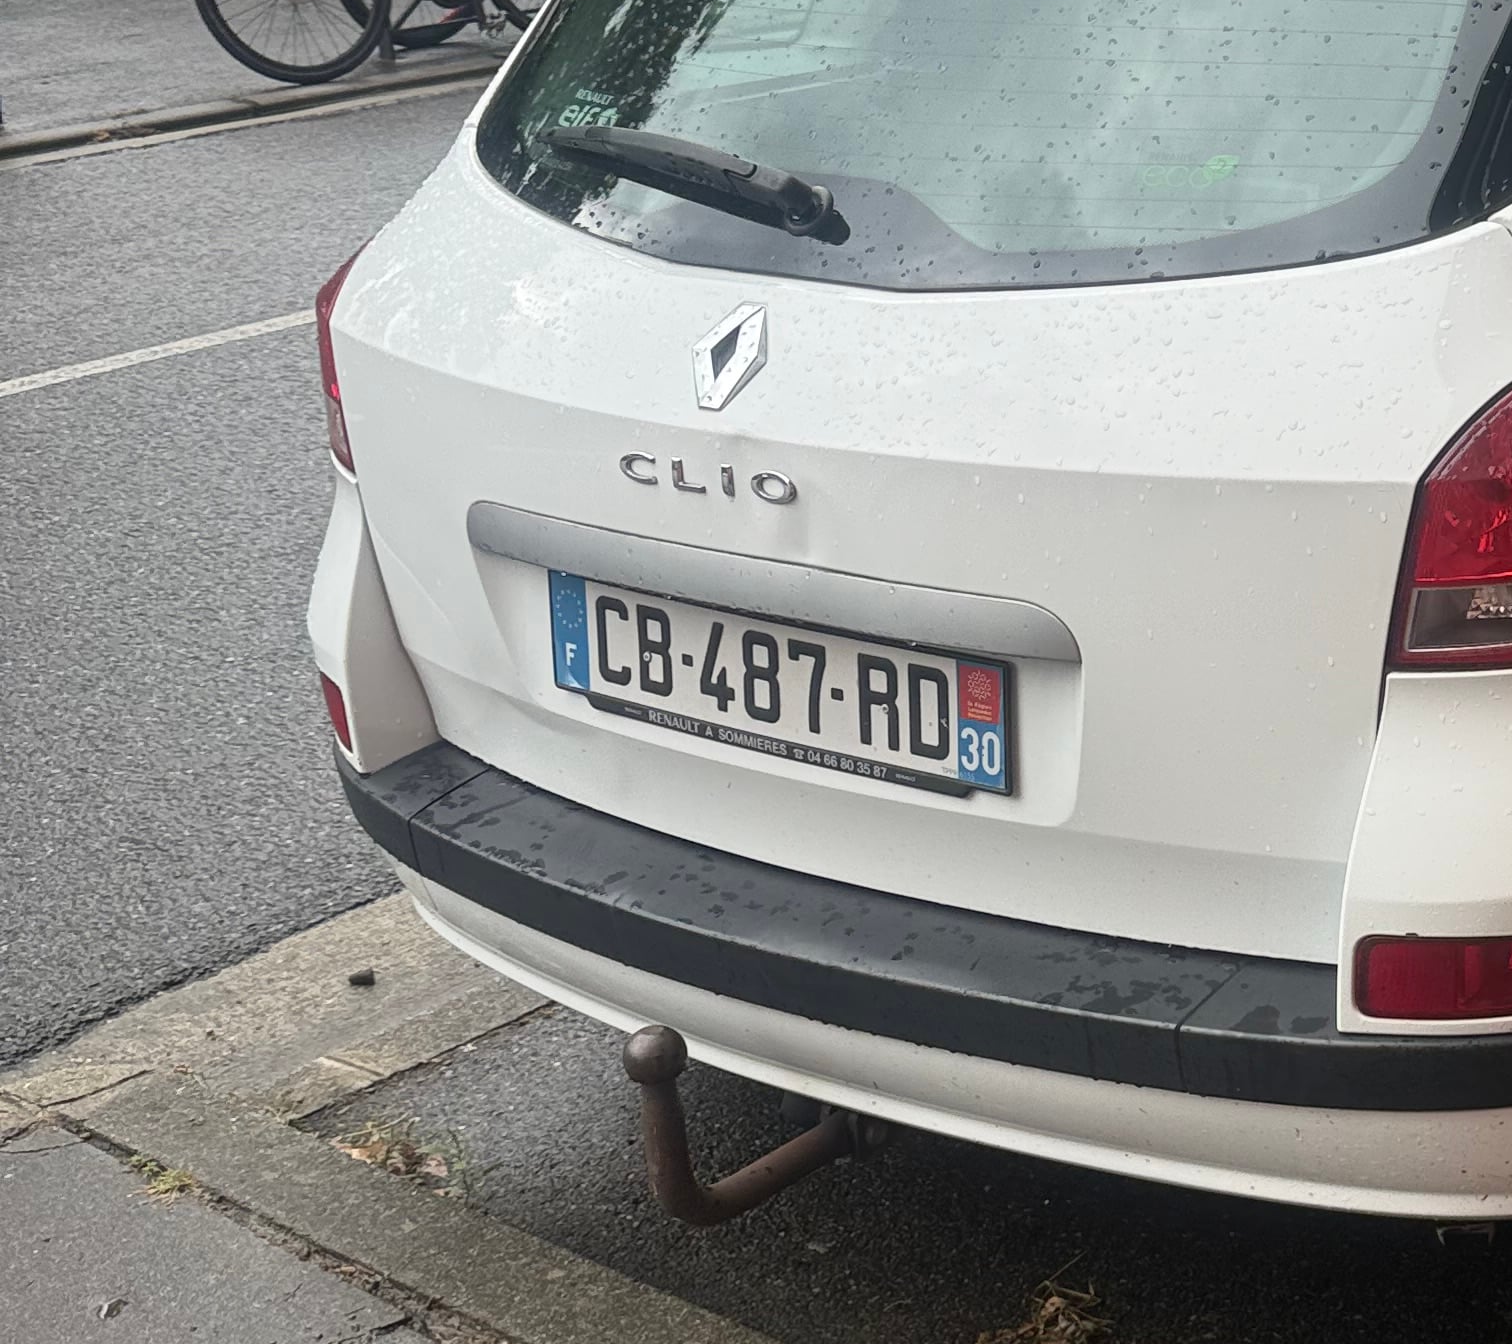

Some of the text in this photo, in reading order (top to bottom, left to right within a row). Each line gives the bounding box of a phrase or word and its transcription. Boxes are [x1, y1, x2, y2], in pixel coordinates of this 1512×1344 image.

[575, 88, 614, 106] RENAULT
[619, 450, 798, 504] CLIO
[565, 642, 577, 666] F
[596, 595, 950, 761] CB-487-RD
[648, 710, 701, 734] RENAULT
[705, 726, 713, 737] A
[718, 728, 788, 756] SOMMIERES
[807, 750, 821, 764] 04
[823, 754, 838, 768] 66
[840, 758, 855, 772] 80
[856, 761, 871, 775] 35
[873, 765, 887, 779] 87
[960, 727, 1001, 776] 30
